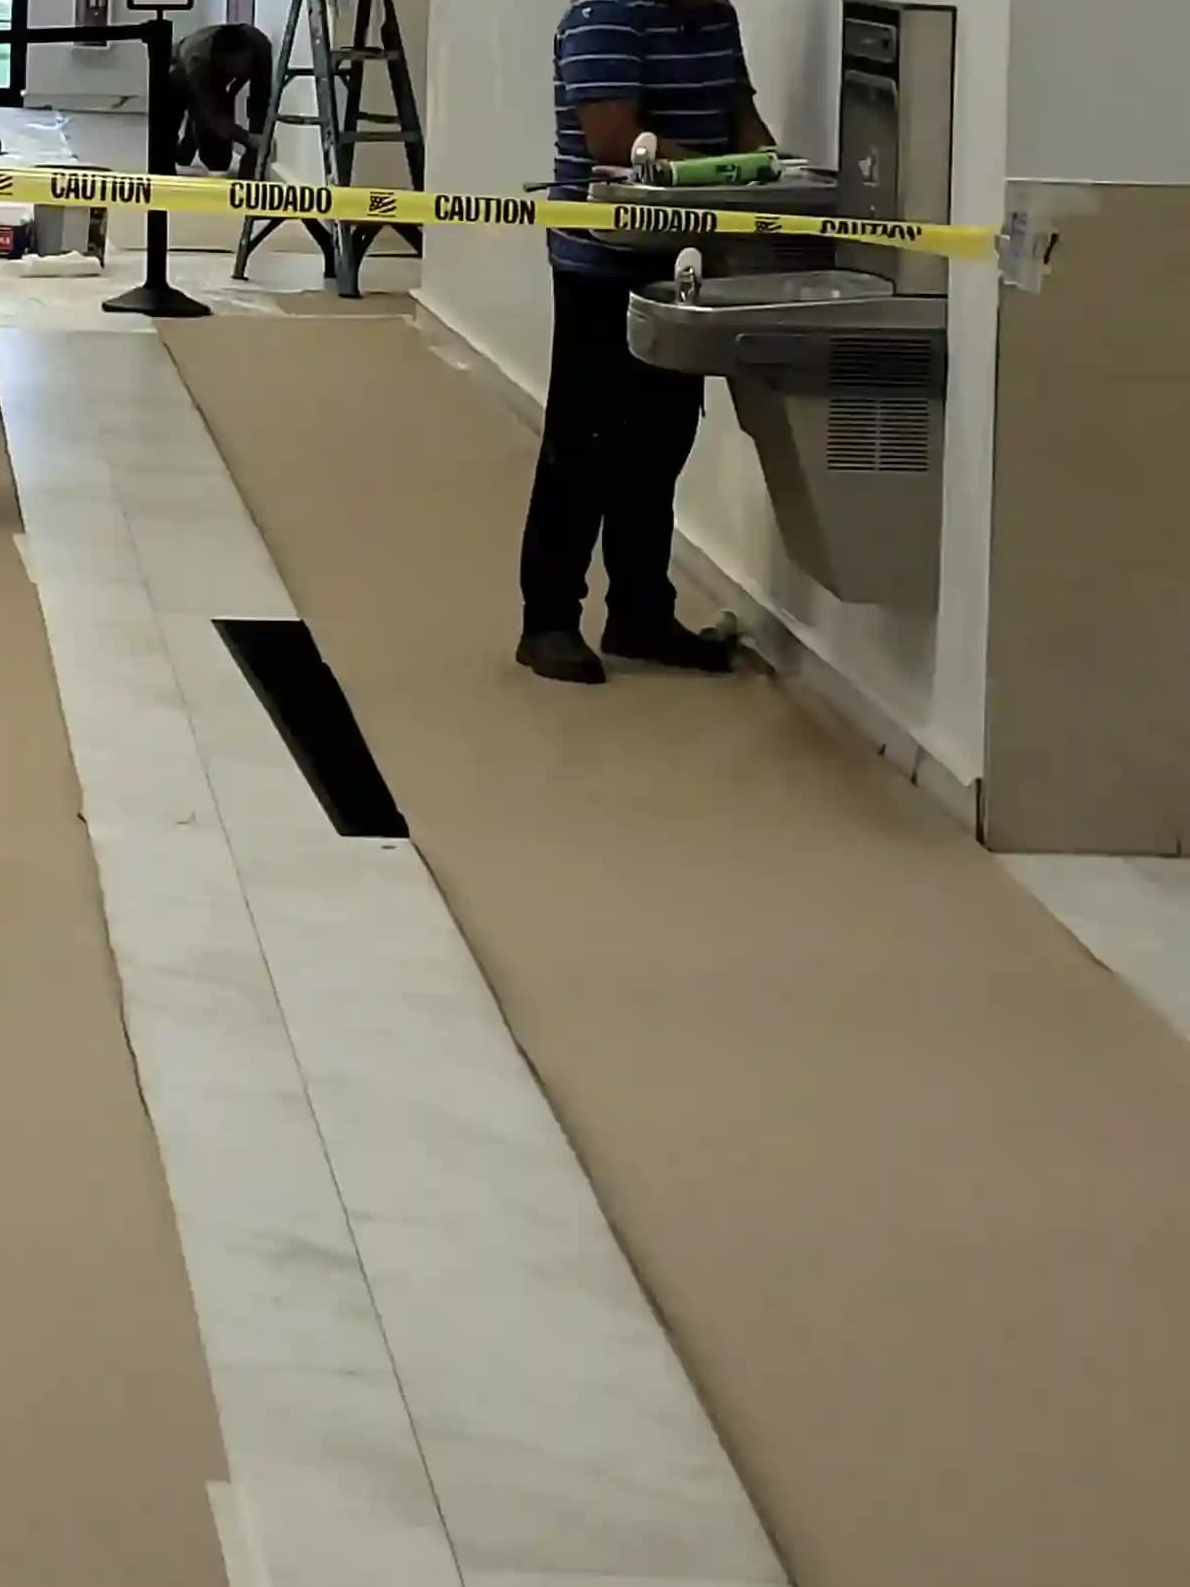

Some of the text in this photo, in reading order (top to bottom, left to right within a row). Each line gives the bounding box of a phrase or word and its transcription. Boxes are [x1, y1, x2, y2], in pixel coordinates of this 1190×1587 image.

[50, 172, 152, 204] CAUTION
[229, 181, 332, 213] CUIDADO
[434, 194, 535, 225] CAUTION
[613, 205, 717, 232] CUIDADO
